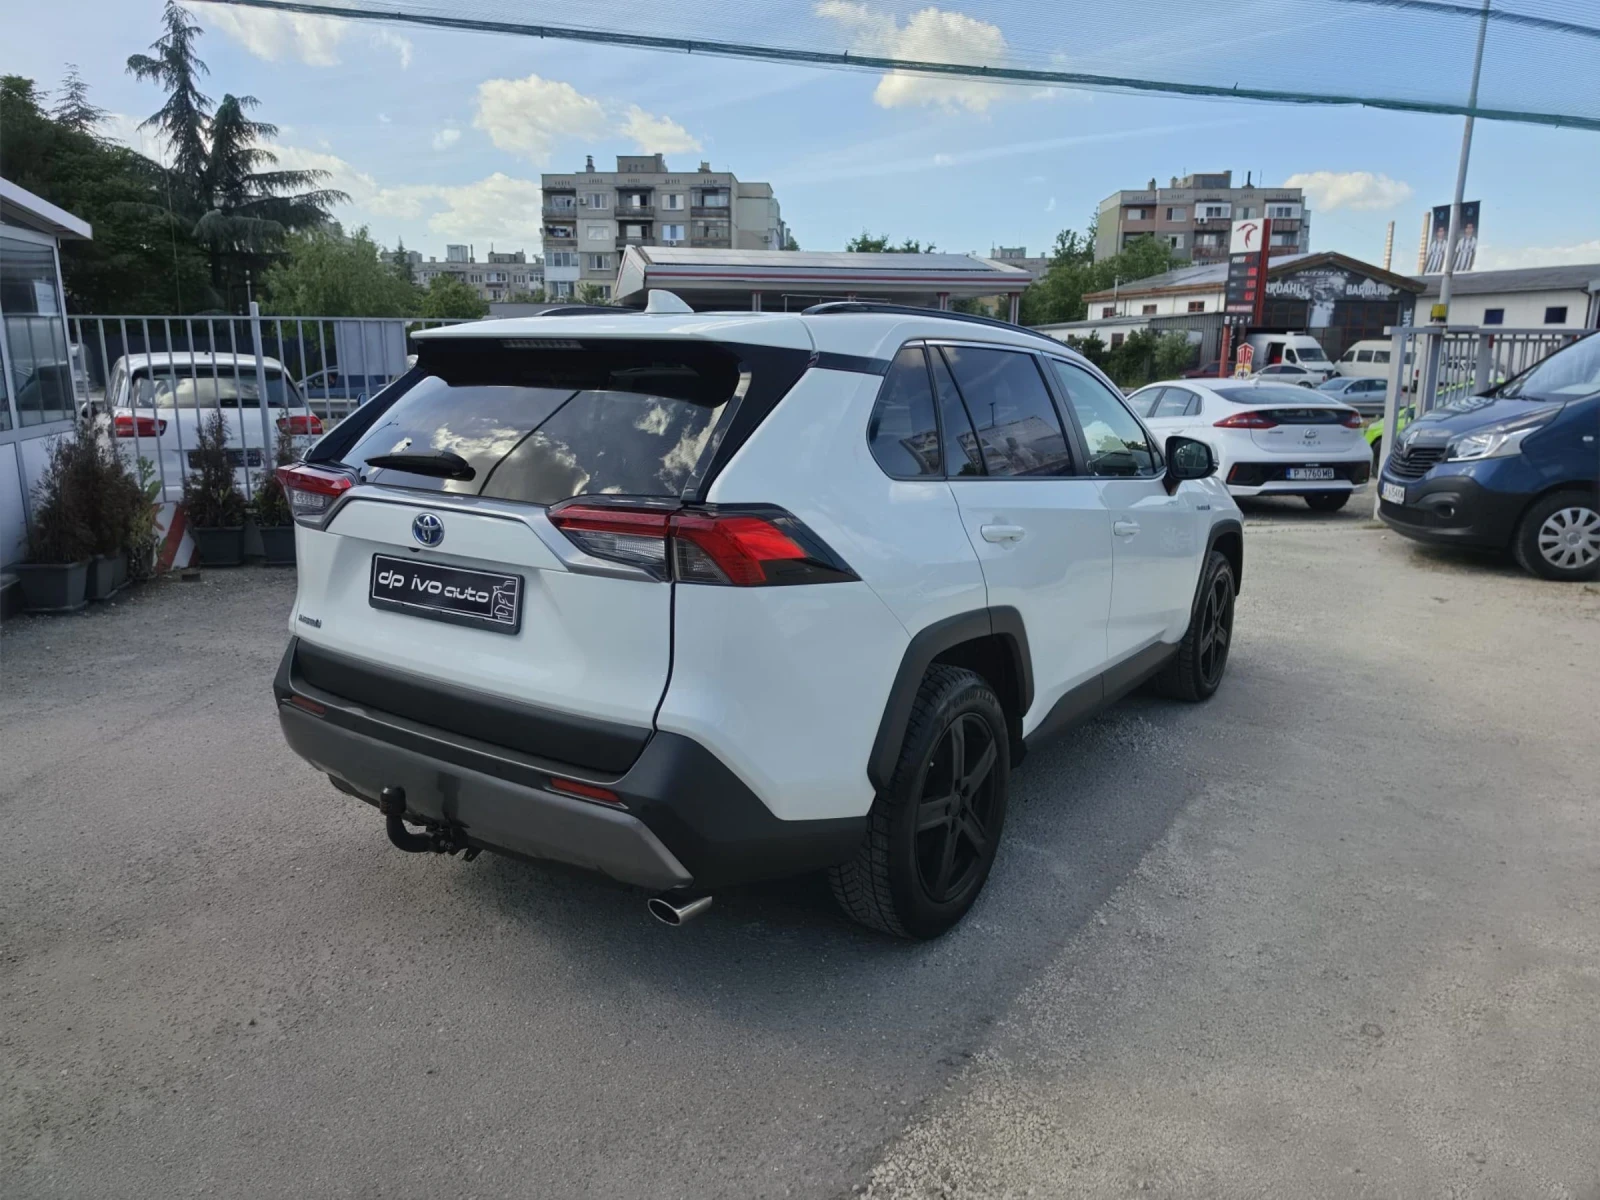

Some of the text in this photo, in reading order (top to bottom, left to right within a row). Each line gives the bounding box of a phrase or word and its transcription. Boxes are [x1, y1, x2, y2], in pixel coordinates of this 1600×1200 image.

[378, 570, 489, 603] dp ivo auto
